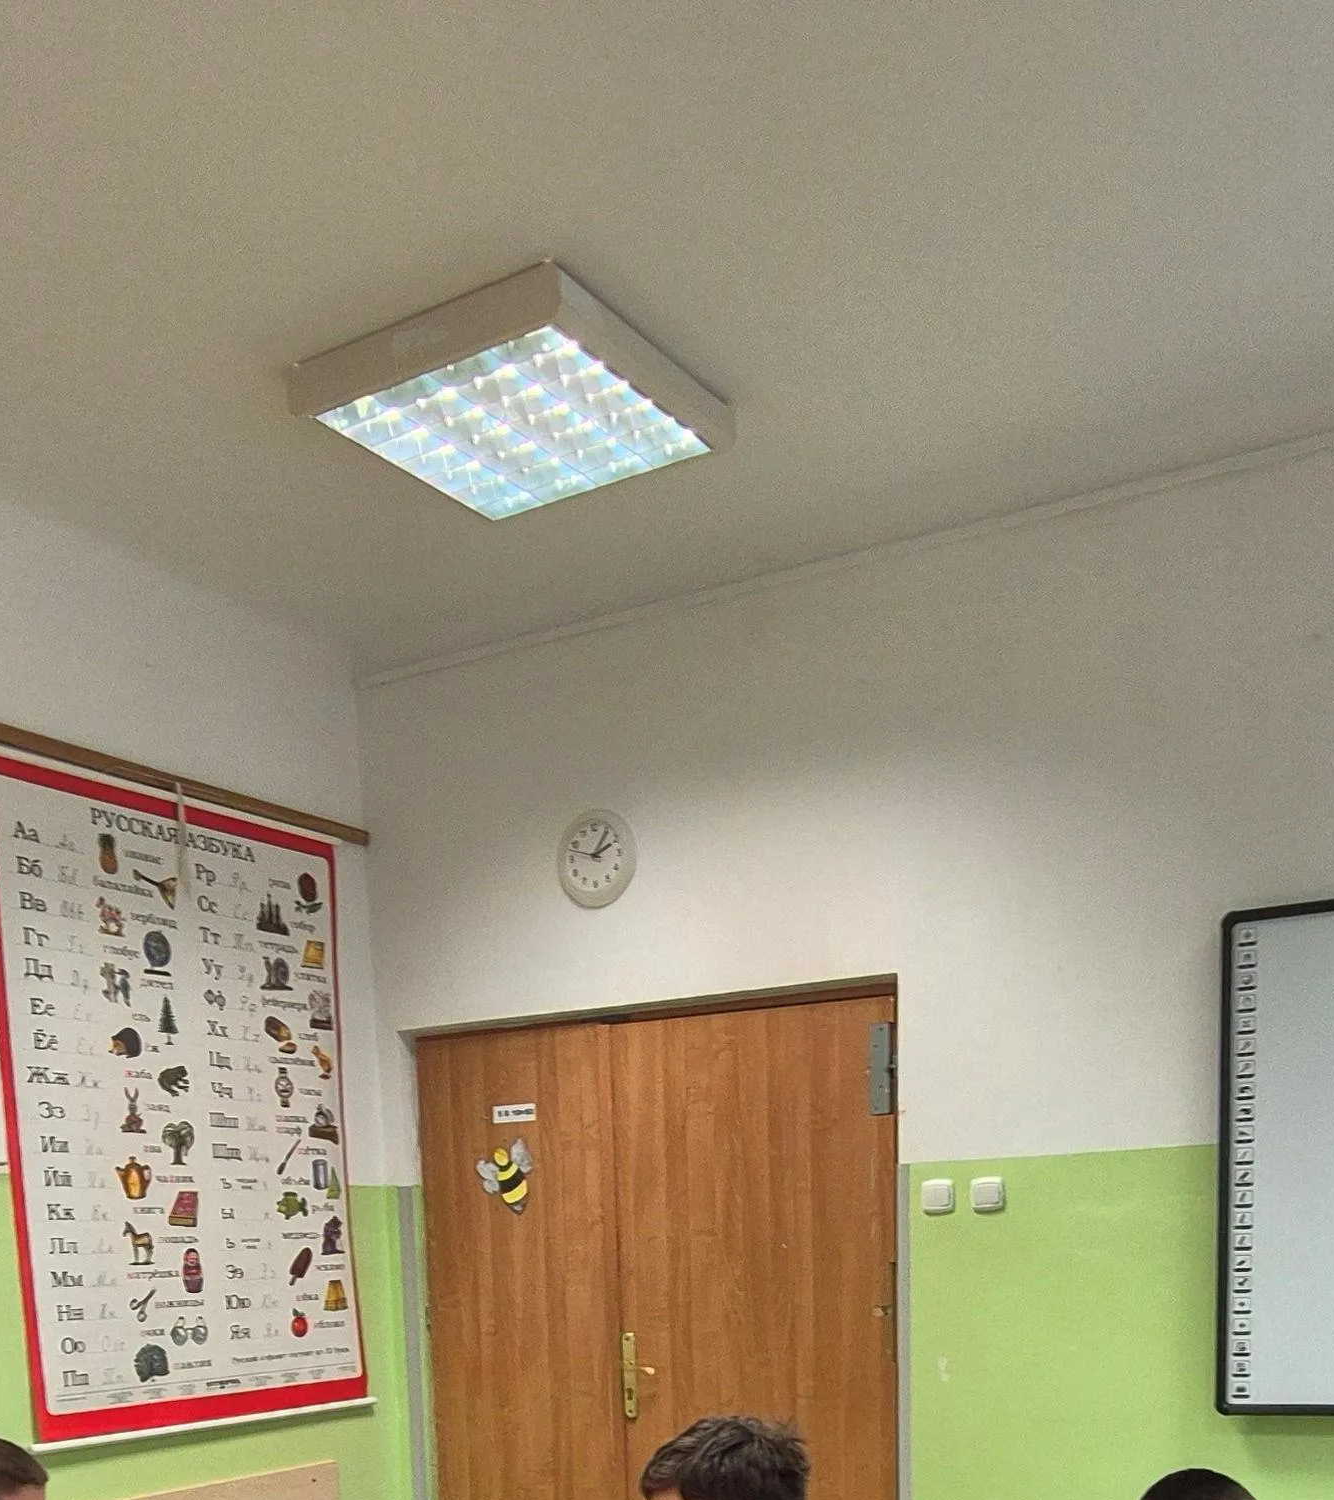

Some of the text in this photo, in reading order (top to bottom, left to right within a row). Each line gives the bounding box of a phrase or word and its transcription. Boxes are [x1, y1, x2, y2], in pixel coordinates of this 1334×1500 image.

[13, 821, 39, 843] Аа
[91, 808, 179, 844] РУССКАЯ
[184, 833, 255, 862] АЗБУКА
[16, 856, 42, 877] Бб
[30, 998, 55, 1016] Ее
